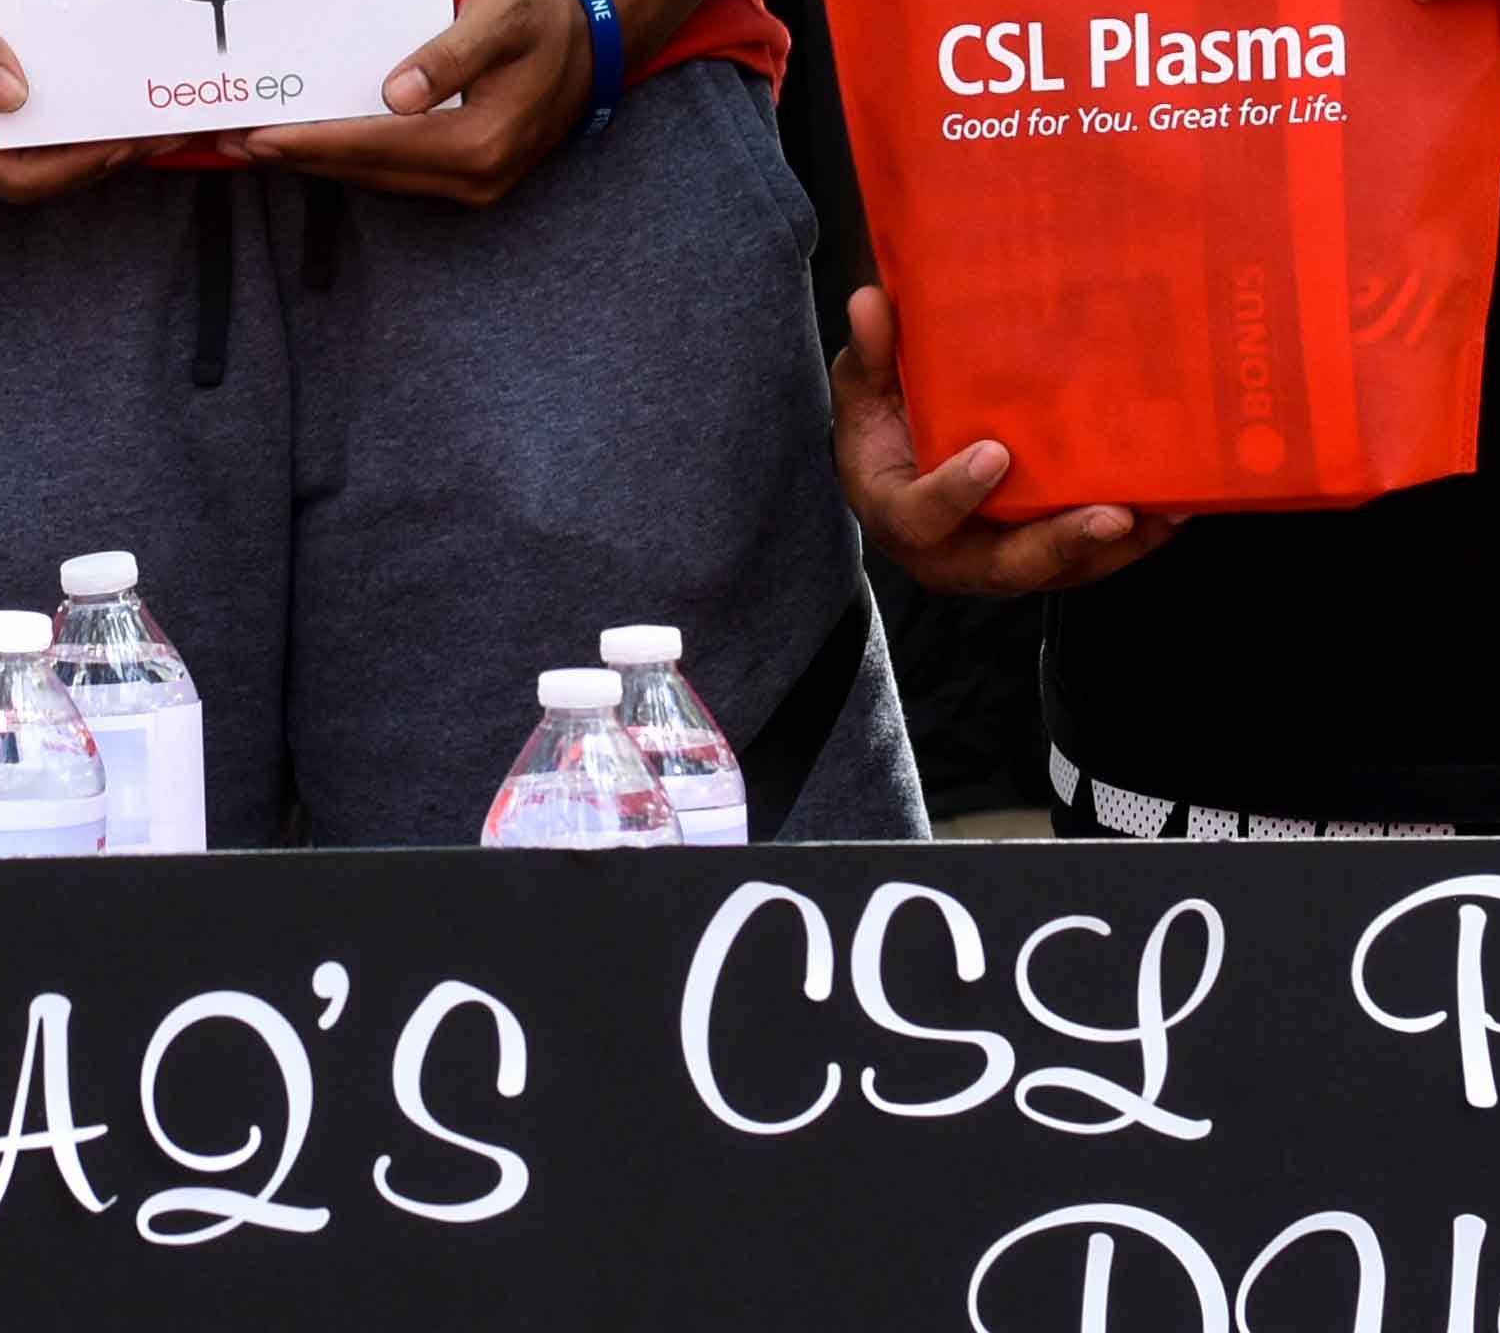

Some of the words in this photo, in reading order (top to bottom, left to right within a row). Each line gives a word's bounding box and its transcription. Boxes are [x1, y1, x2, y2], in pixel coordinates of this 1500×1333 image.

[938, 21, 1065, 95] CSL
[1089, 12, 1347, 88] Plasma
[147, 72, 249, 108] beats
[255, 73, 304, 106] ep
[942, 111, 1020, 140] Good
[1027, 109, 1069, 136] for
[1078, 107, 1137, 134] You.
[1149, 103, 1231, 130] Great
[1239, 98, 1281, 126] for
[1289, 93, 1348, 124] Life.
[681, 879, 1226, 1141] CSL
